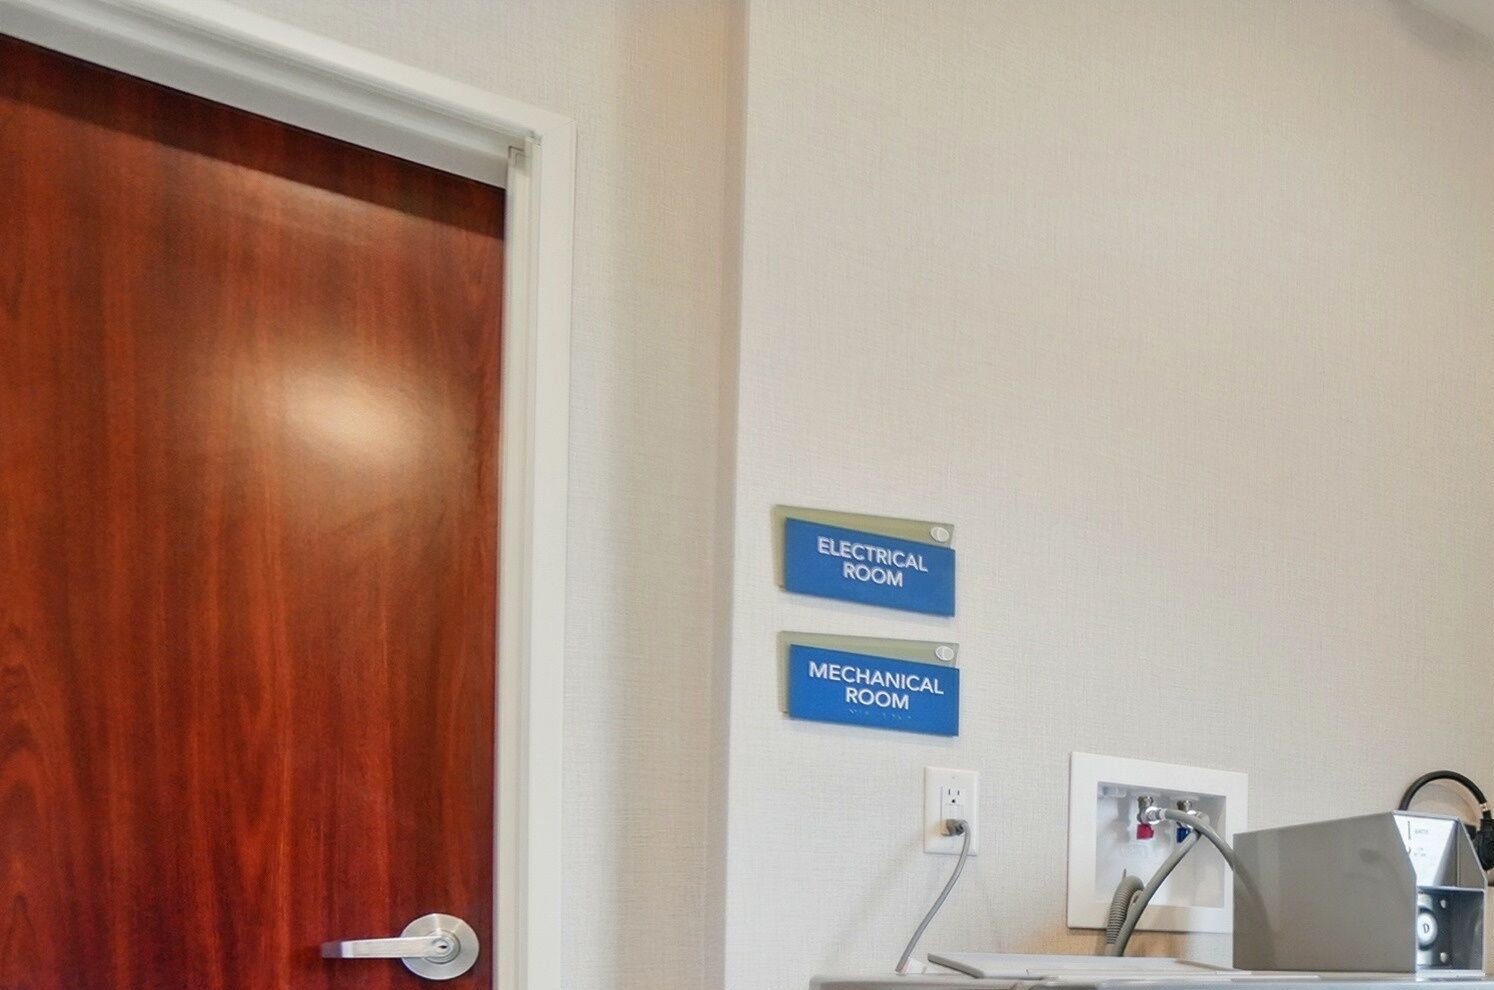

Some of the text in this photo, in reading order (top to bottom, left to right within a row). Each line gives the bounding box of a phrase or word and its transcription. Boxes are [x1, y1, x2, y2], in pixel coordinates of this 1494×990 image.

[817, 535, 928, 573] ELECTRICAL
[843, 562, 903, 588] ROOM
[809, 660, 944, 695] MECHANICAL
[845, 687, 909, 710] ROOM
